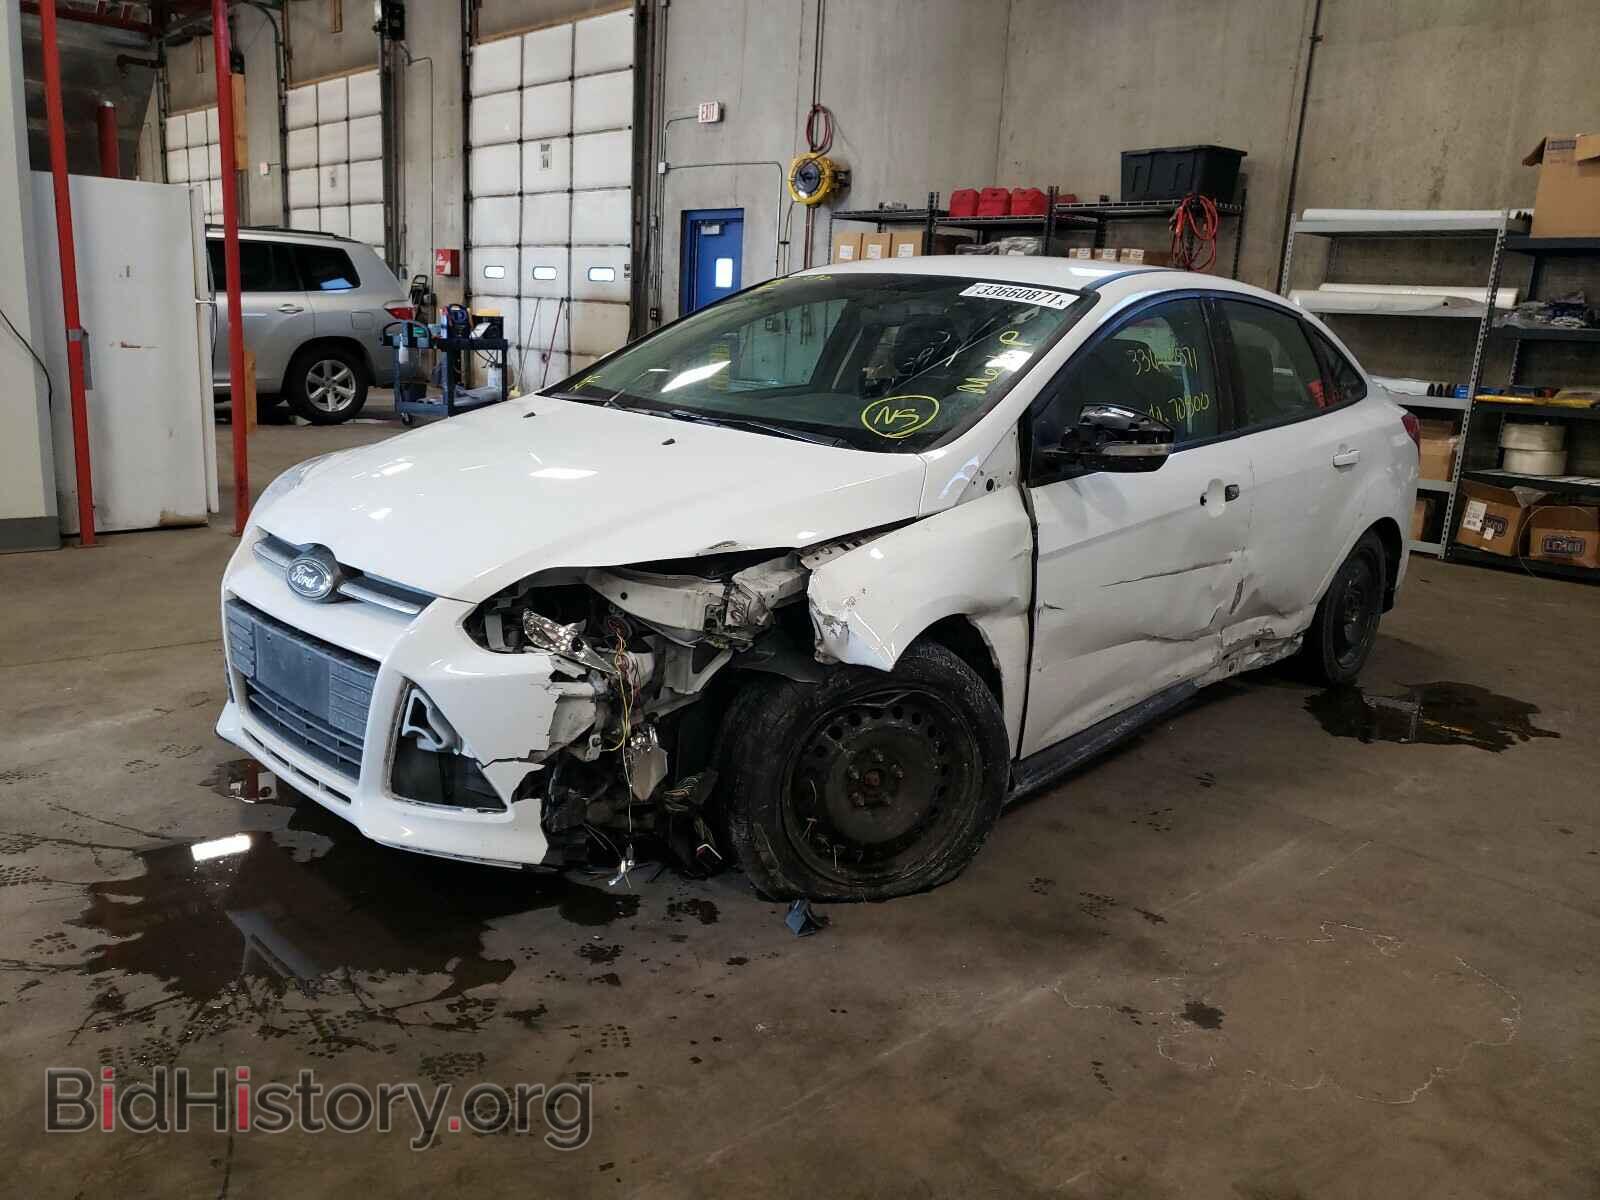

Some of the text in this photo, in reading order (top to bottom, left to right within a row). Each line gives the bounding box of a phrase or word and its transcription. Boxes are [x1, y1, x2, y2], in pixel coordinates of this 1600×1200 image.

[701, 103, 716, 121] EXIT
[977, 285, 1061, 304] 33660871
[873, 404, 920, 430] NS
[291, 564, 319, 588] Ford
